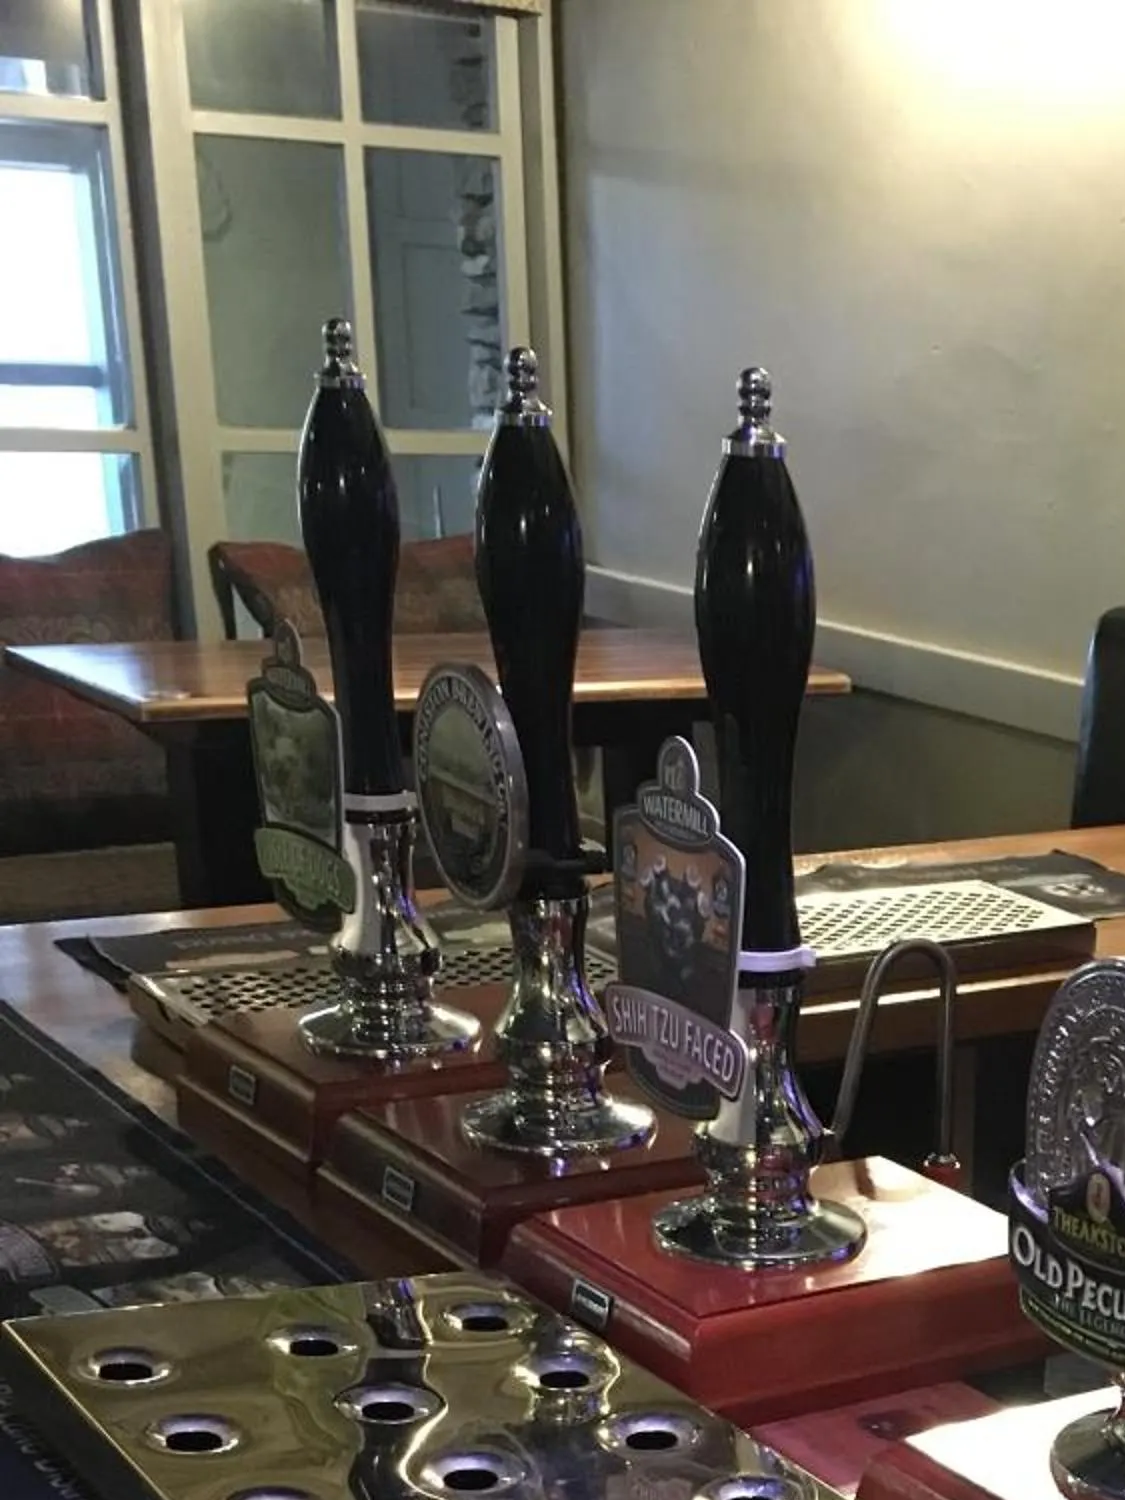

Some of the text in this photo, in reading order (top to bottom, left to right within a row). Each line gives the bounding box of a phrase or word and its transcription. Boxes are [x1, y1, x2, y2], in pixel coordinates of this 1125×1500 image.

[642, 794, 709, 837] WATERMILL
[612, 994, 648, 1035] SHIH
[650, 1003, 681, 1049] TZU
[682, 1017, 736, 1083] FACED
[1012, 1225, 1064, 1289] OLD
